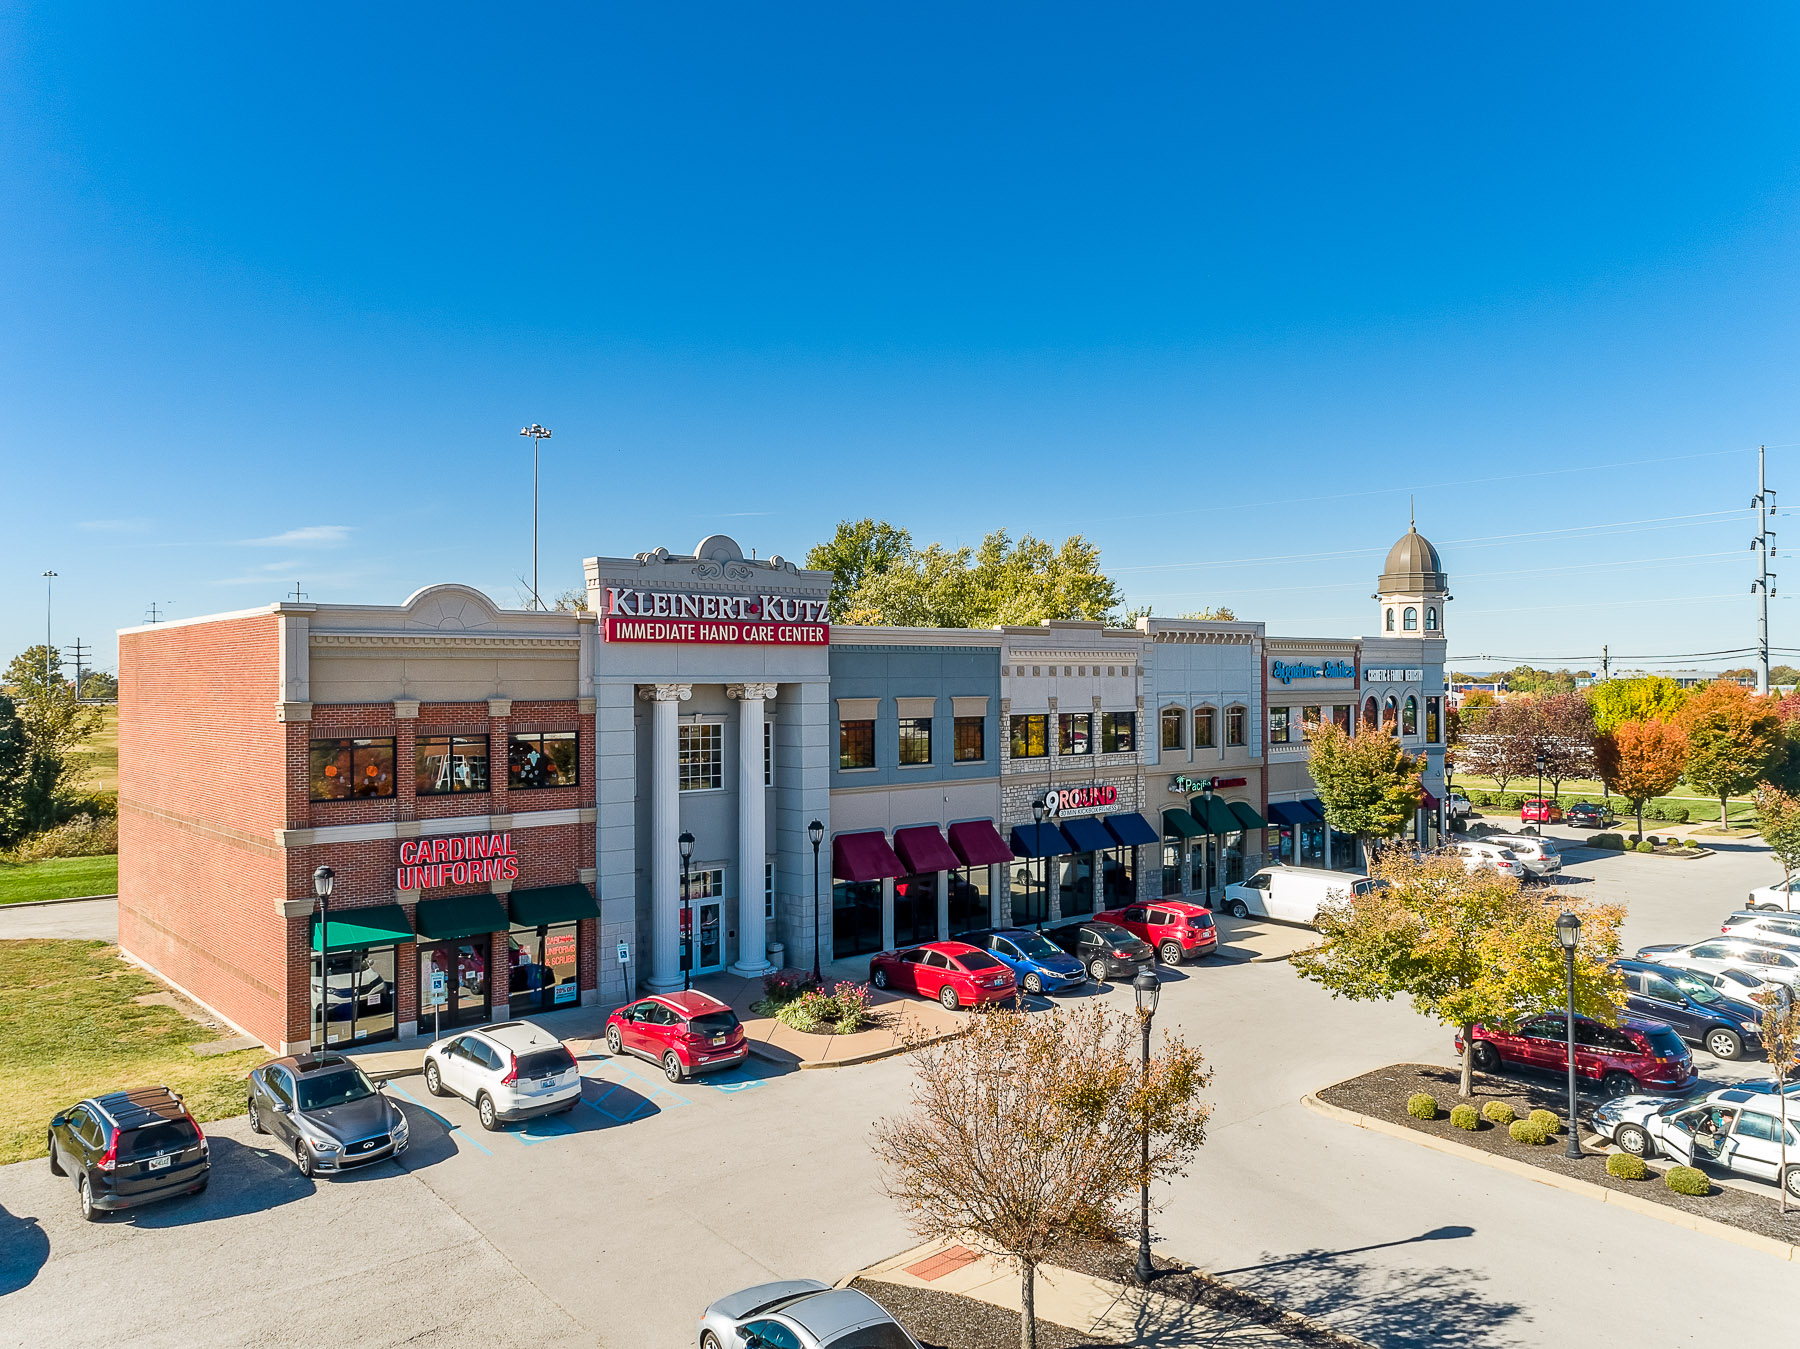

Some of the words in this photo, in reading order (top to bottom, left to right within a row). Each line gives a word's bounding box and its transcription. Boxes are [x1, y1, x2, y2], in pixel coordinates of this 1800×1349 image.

[606, 587, 750, 620] KLEINERT
[759, 595, 829, 622] KUTZ
[616, 622, 696, 640] IMMEDIATE
[700, 624, 739, 641] HAND
[742, 625, 775, 642] CARE
[778, 626, 824, 642] CENTER
[1273, 661, 1322, 684] Signature
[1323, 660, 1356, 679] Smiles
[1077, 806, 1099, 815] KICKBOX
[400, 834, 517, 866] CARDINAL
[397, 857, 518, 890] UNIFORMS
[545, 944, 576, 956] UNIFORMS
[551, 955, 576, 966] SCRUBS
